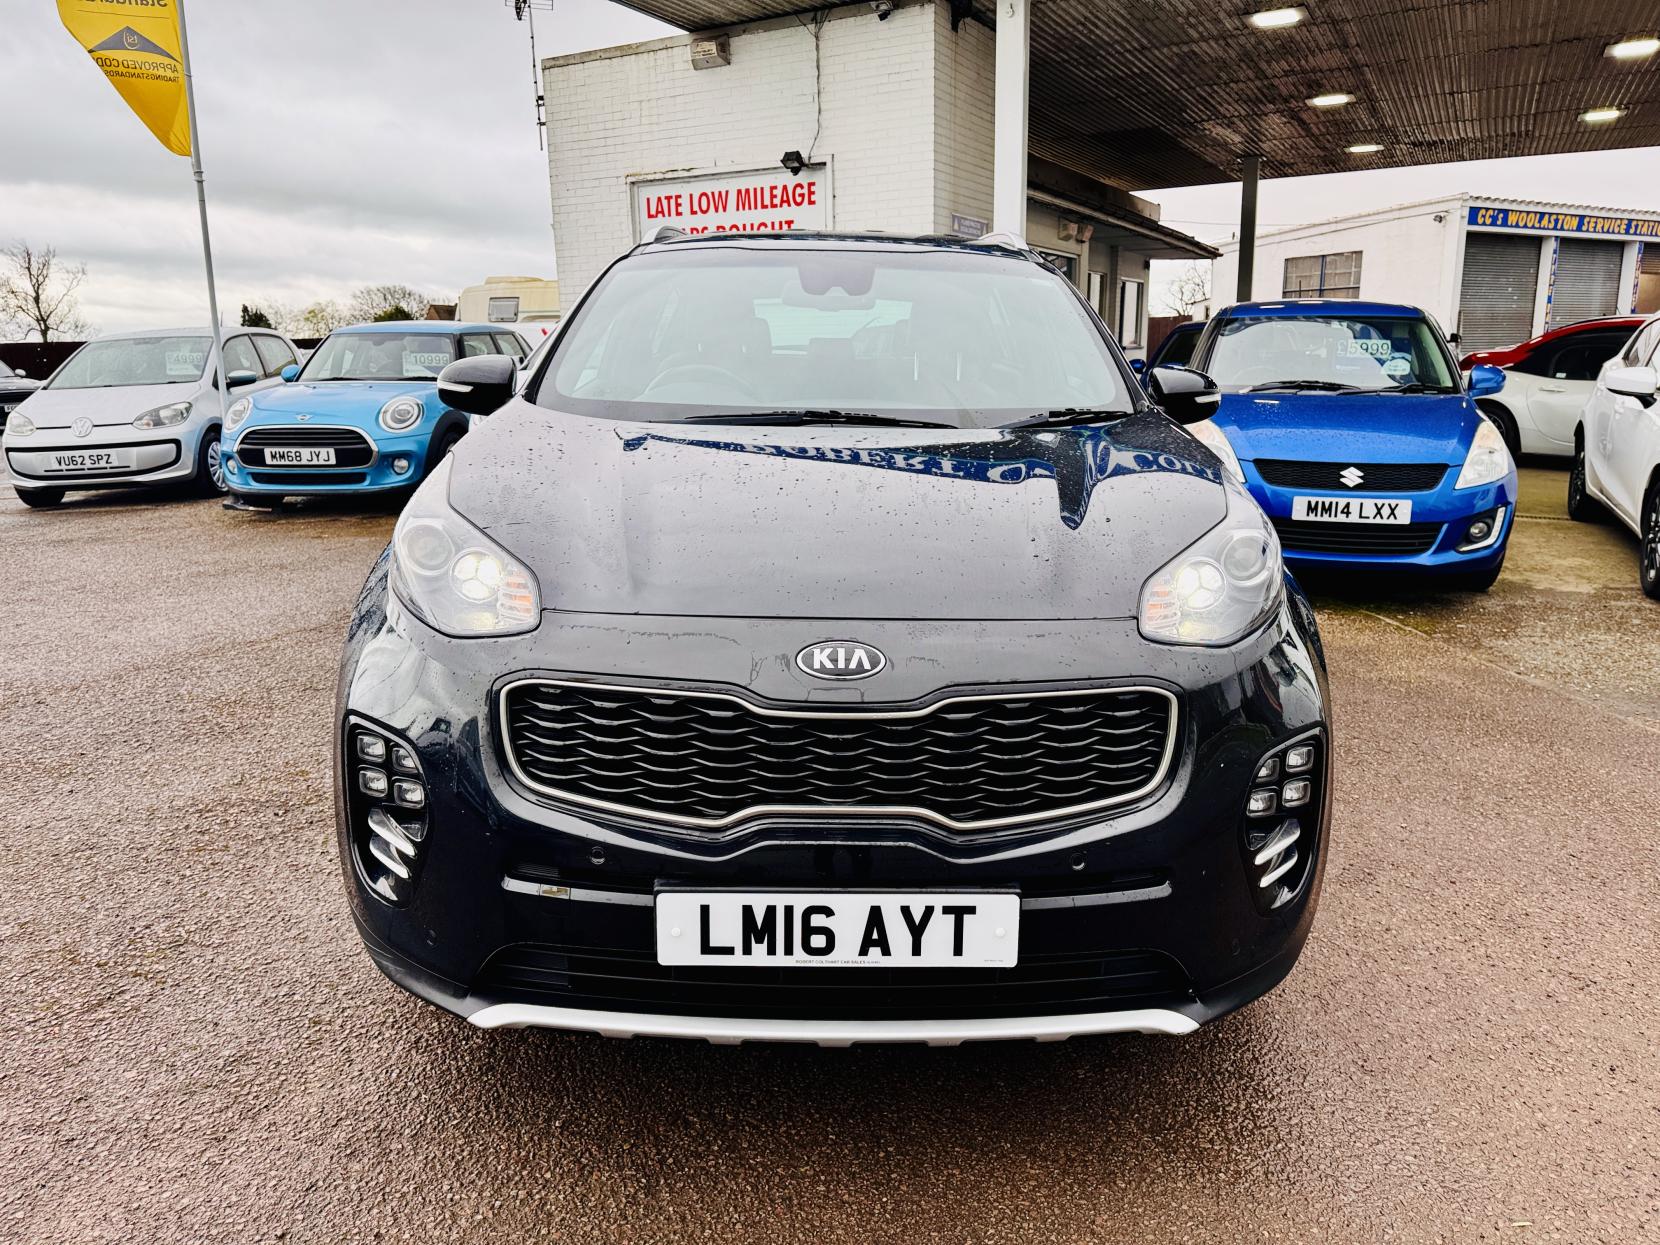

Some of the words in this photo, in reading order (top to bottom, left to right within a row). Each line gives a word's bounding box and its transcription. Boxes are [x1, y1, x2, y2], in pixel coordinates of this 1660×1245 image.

[646, 194, 683, 219] LATE
[689, 190, 730, 216] LOW
[736, 182, 816, 212] MILEAGE
[1508, 210, 1580, 230] WOOLASTON
[1582, 216, 1628, 234] SERVICE
[55, 455, 86, 467] VU62
[90, 454, 113, 466] SPZ
[270, 450, 302, 462] MM68
[306, 450, 331, 462] JYJ
[1306, 500, 1352, 519] MM14
[1358, 502, 1399, 520] LXX
[811, 647, 872, 670] KIA
[699, 903, 836, 957] LM16
[857, 905, 977, 957] AYT
